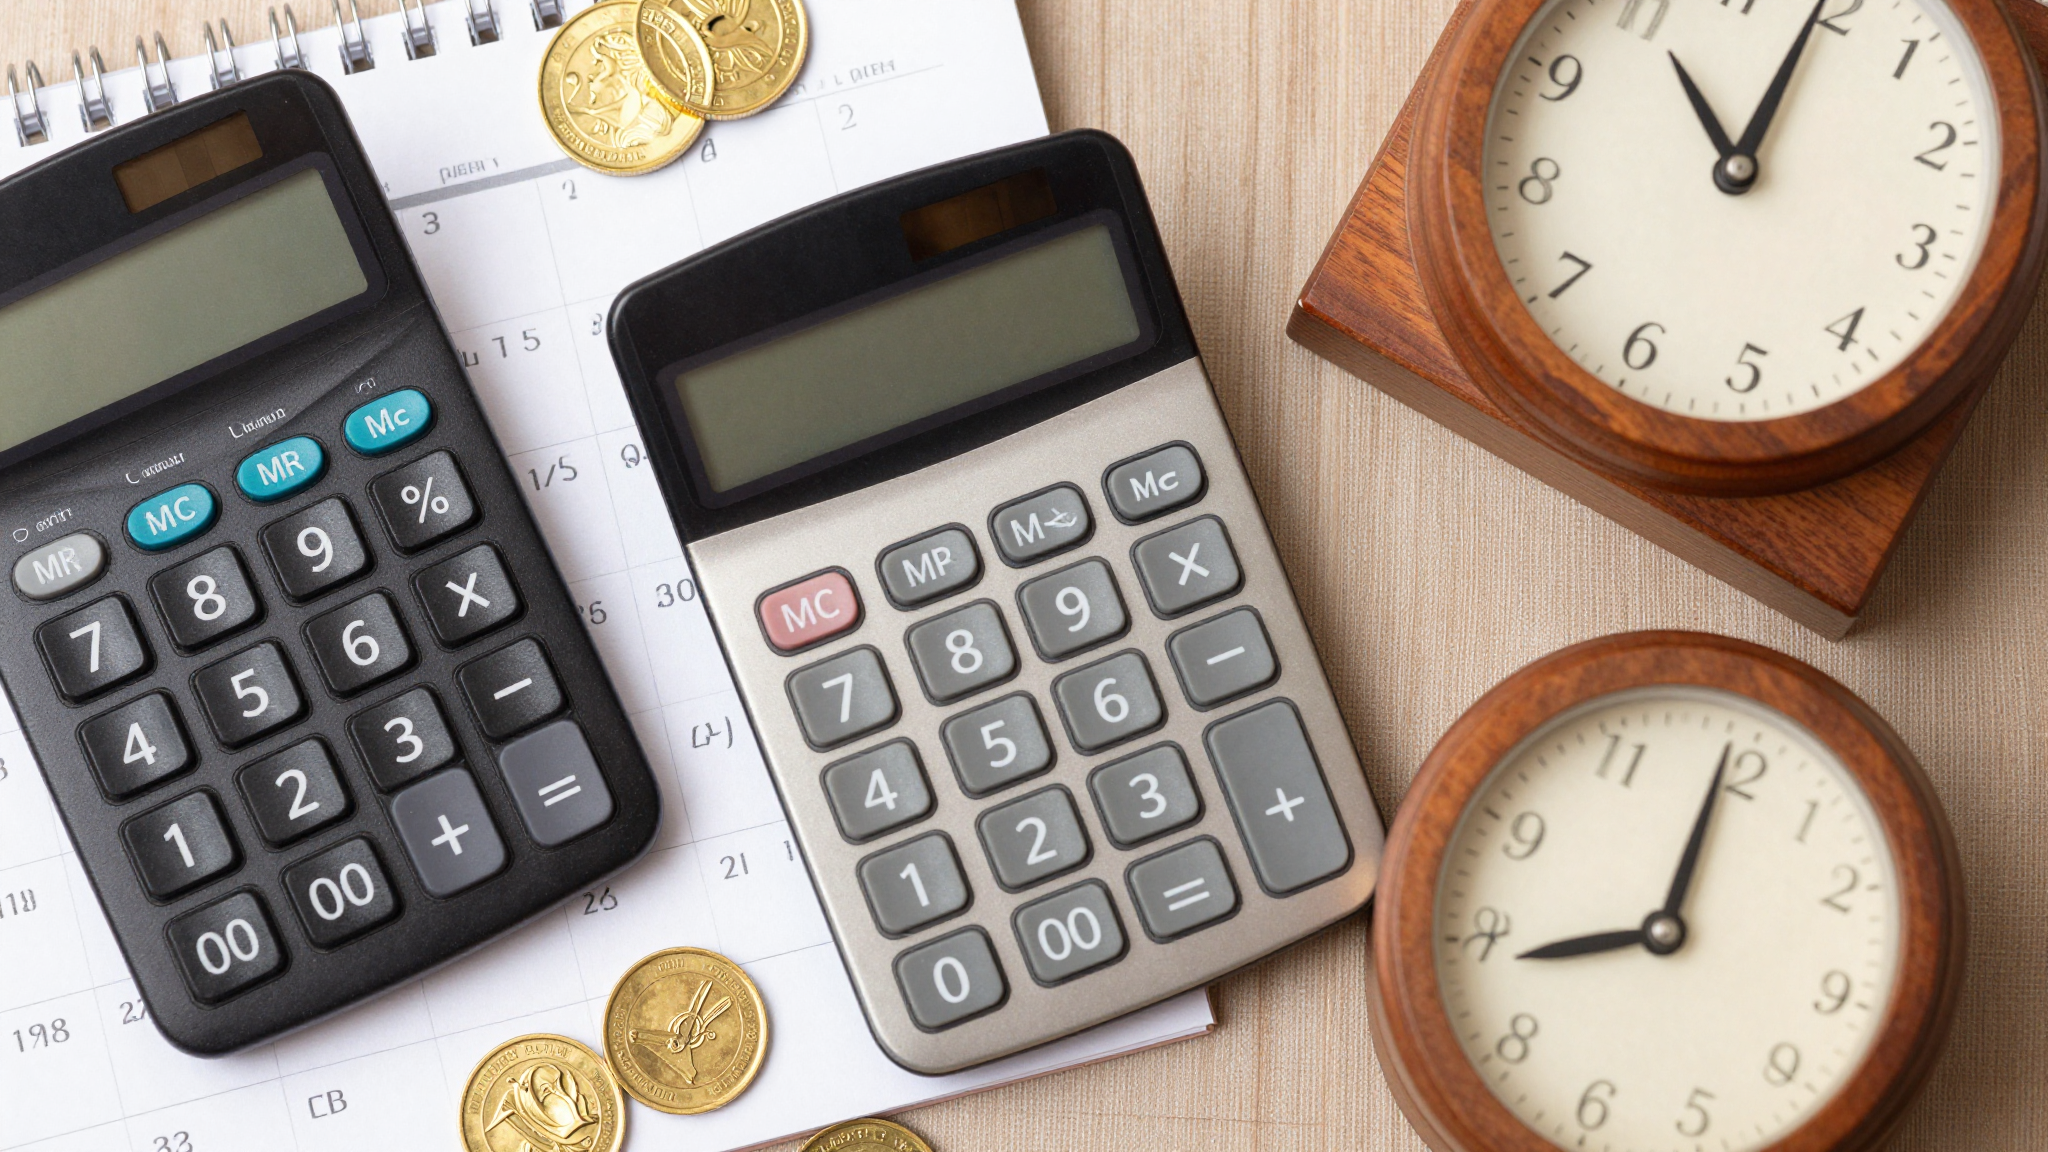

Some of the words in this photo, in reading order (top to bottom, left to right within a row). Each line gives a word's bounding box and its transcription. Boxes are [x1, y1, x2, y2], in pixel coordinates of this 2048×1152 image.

[1539, 54, 1583, 101] 9
[1893, 40, 1919, 79] 1
[839, 104, 857, 130] 2
[1914, 122, 1956, 171] 2
[1518, 157, 1560, 205] 8
[422, 212, 440, 235] 3
[1896, 224, 1937, 269] 3
[1547, 251, 1592, 299] 7
[1623, 323, 1665, 370] 6
[1825, 307, 1864, 352] 4
[1726, 343, 1768, 393] 5
[257, 450, 304, 486] MR
[146, 496, 197, 535] MC
[401, 477, 452, 523] %
[297, 527, 333, 572] 9
[187, 575, 226, 620] 8
[656, 576, 696, 607] 30
[780, 589, 840, 633] MC
[1056, 587, 1090, 632] 9
[70, 621, 101, 672] 7
[343, 620, 379, 665] 6
[946, 629, 983, 673] 8
[231, 668, 270, 717] 5
[822, 673, 852, 722] 7
[1094, 678, 1129, 722] 6
[124, 722, 156, 765] 4
[384, 717, 423, 762] 3
[981, 720, 1016, 767] 5
[276, 769, 320, 820] 2
[865, 769, 898, 810] 4
[1129, 773, 1167, 818] 3
[1016, 817, 1057, 865] 2
[1502, 811, 1546, 859] 9
[1795, 800, 1819, 843] 1
[164, 823, 194, 867] 1
[309, 863, 374, 920] 00
[900, 863, 929, 906] 1
[1820, 865, 1860, 914] 2
[197, 919, 259, 974] 00
[1038, 907, 1101, 960] 00
[934, 957, 970, 1003] 0
[1497, 1014, 1538, 1064] 8
[1575, 1080, 1616, 1132] 6
[1675, 1087, 1715, 1138] 5
